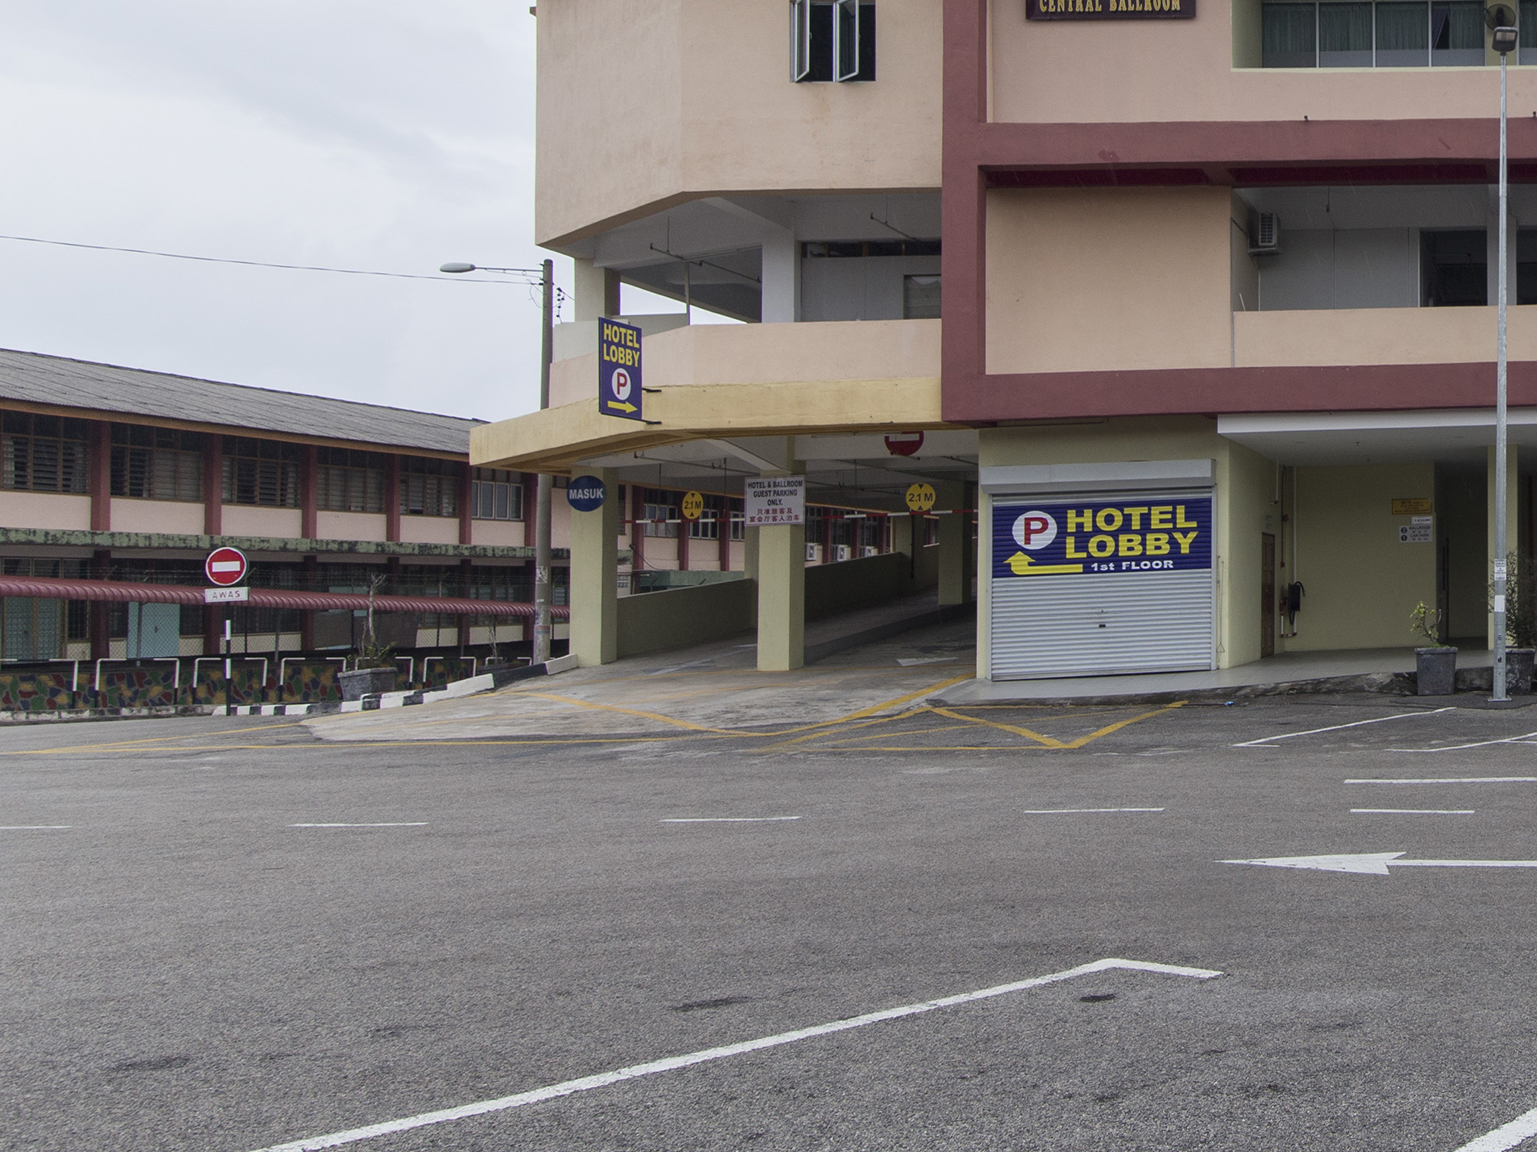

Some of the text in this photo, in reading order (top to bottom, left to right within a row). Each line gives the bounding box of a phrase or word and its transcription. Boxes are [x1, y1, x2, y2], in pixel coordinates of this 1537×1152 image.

[603, 323, 640, 349] HOTEL
[603, 343, 640, 367] LOBBY
[617, 372, 628, 395] P
[569, 488, 604, 500] MASUK
[909, 492, 933, 502] 2.1 M
[1024, 517, 1049, 544] P
[1066, 505, 1198, 533] HOTEL
[1065, 531, 1199, 559] LOBBY
[1090, 560, 1174, 571] 1st FLOOR
[212, 590, 240, 599] AWAS
